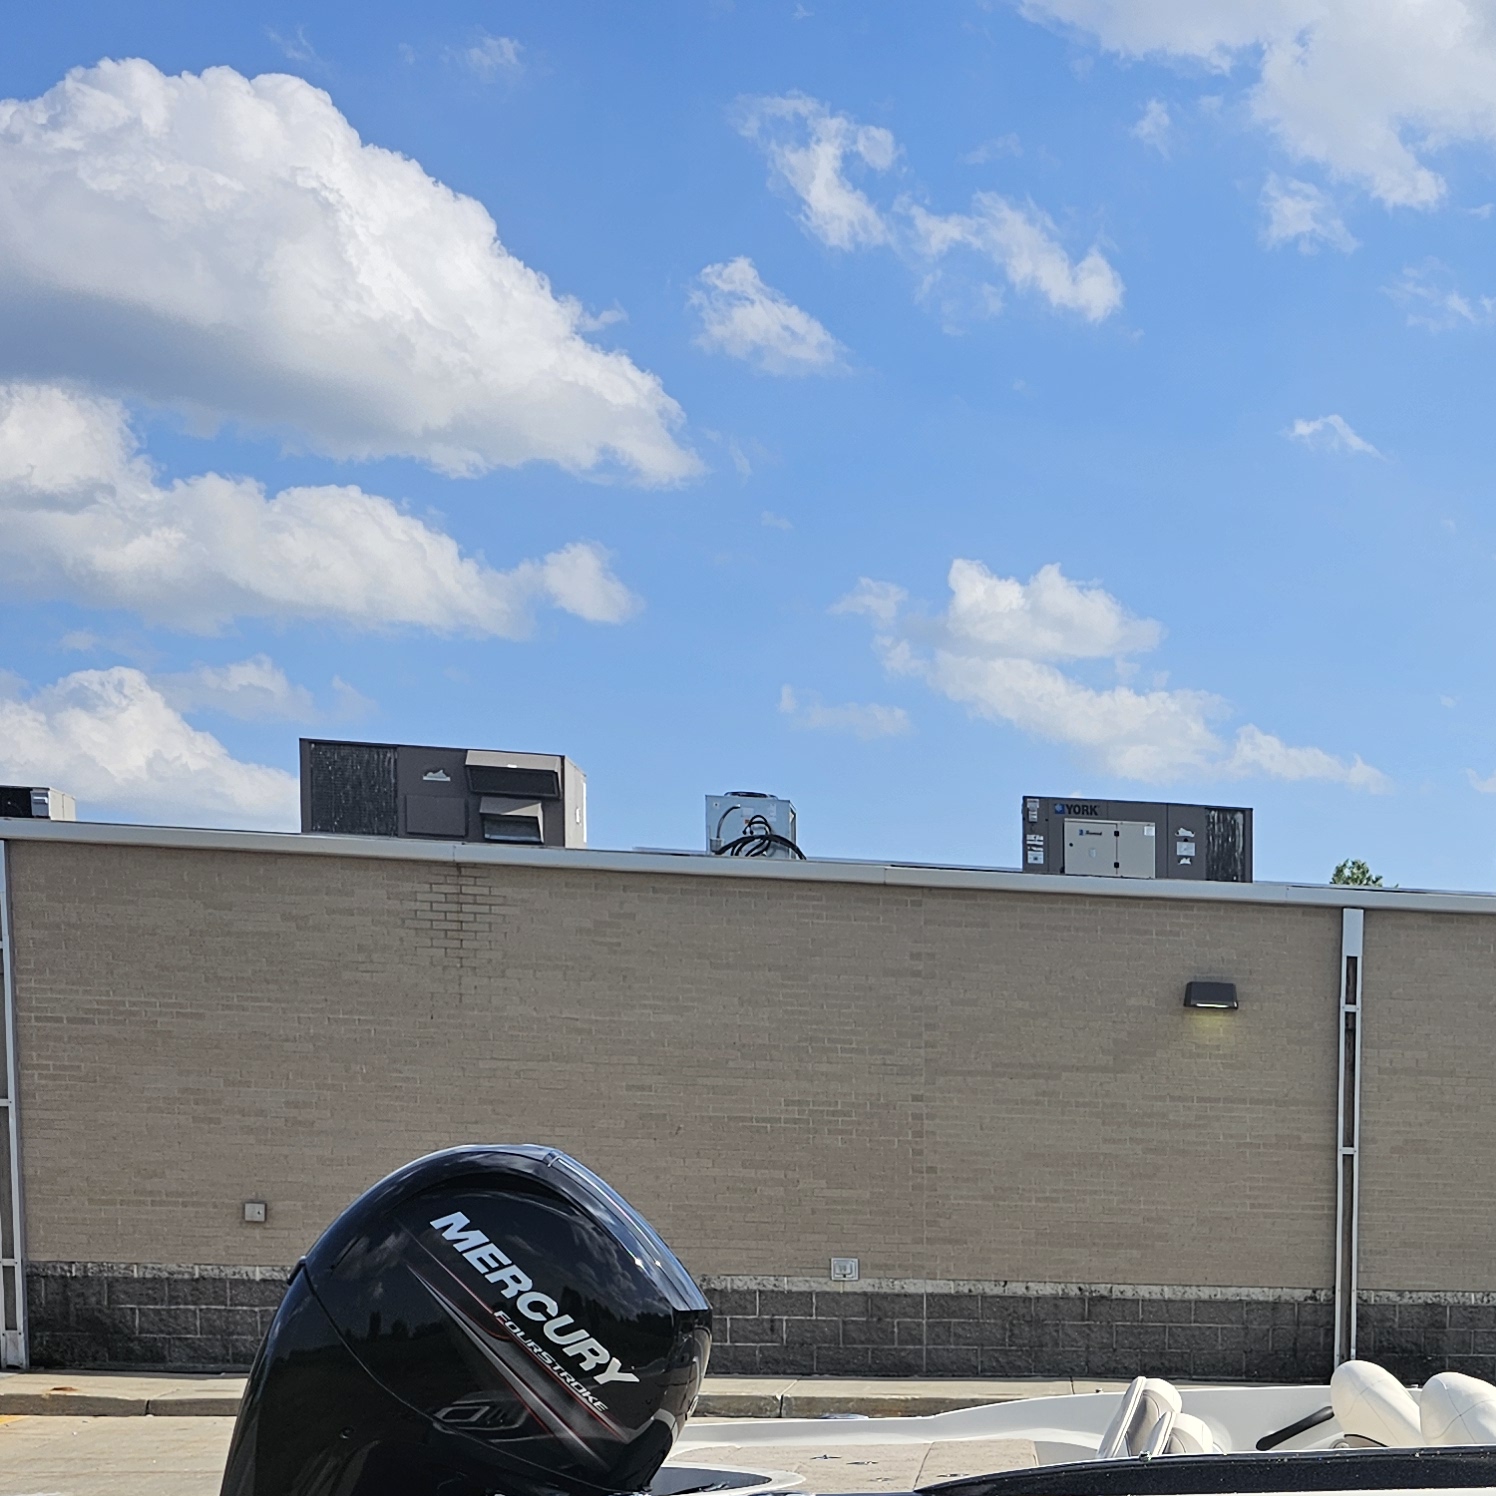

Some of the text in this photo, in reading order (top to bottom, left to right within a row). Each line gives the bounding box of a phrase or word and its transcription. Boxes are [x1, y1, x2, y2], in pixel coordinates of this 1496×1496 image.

[1065, 804, 1098, 816] YORK
[430, 1211, 640, 1385] MERCURY
[493, 1310, 608, 1412] FOURSTROKE
